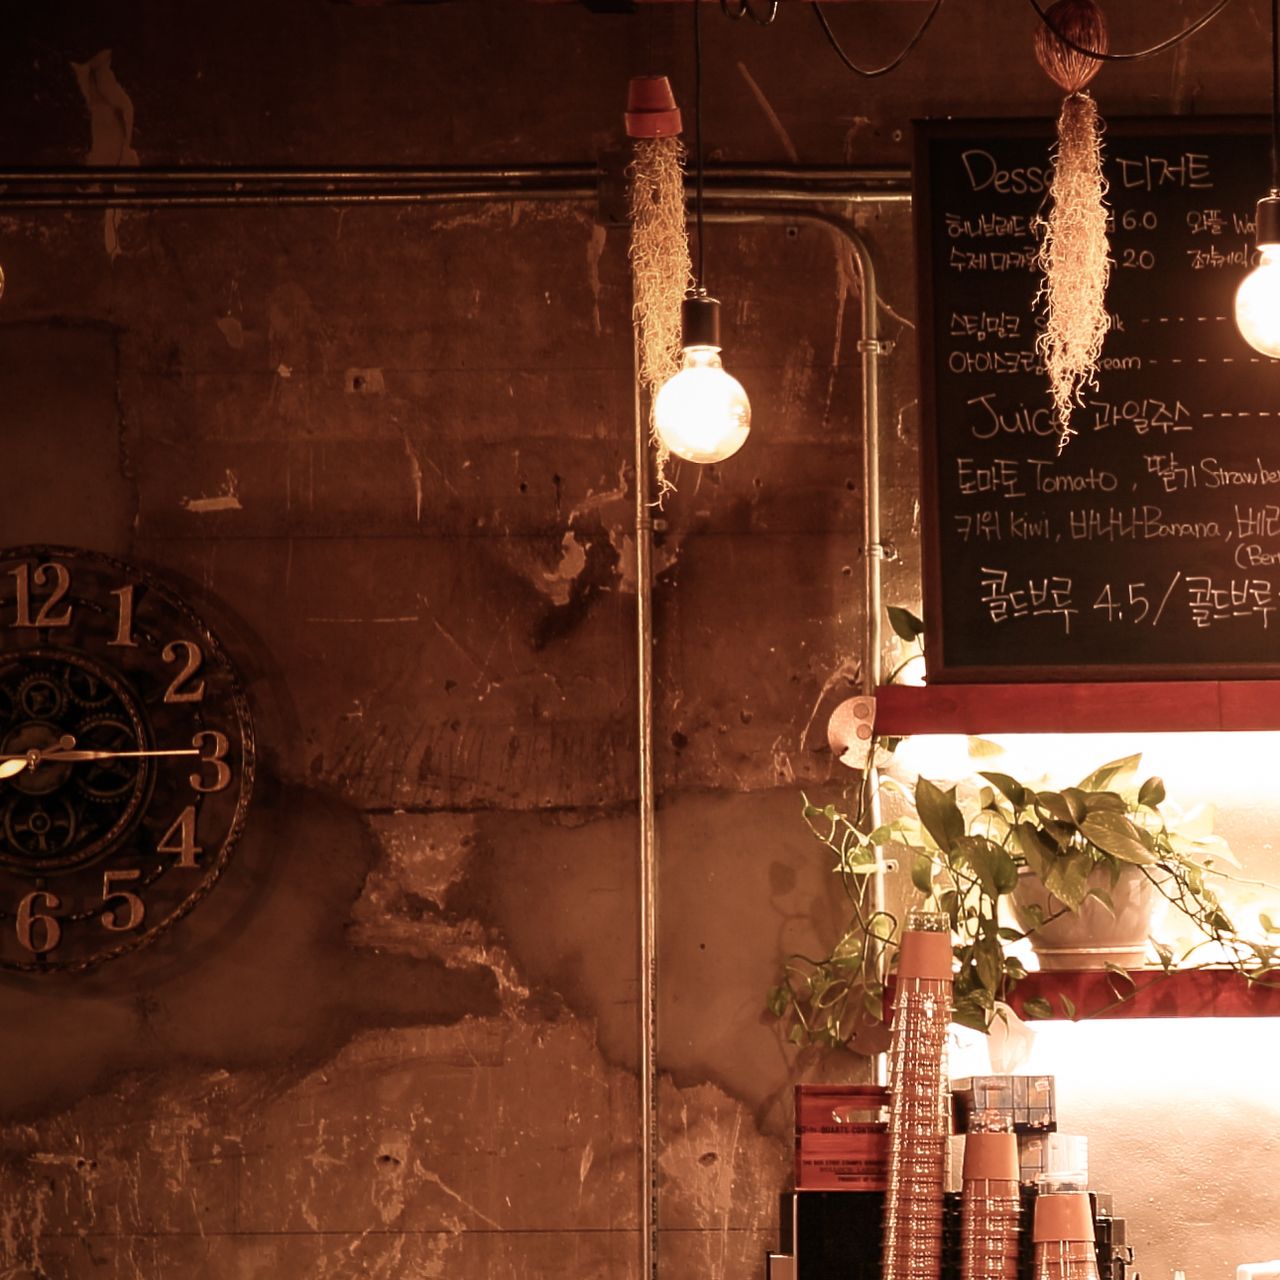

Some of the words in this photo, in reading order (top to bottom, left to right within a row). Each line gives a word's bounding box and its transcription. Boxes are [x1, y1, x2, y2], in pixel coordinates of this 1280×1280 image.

[1116, 153, 1213, 192] 디저트
[1123, 209, 1157, 231] 6.0
[950, 246, 986, 271] 수제
[1123, 247, 1155, 270] 2.0
[950, 312, 1020, 341] 스팀밀크
[957, 458, 1026, 498] 토마토
[1143, 453, 1197, 493] 딸기
[954, 510, 1001, 541] 키위
[8, 562, 73, 628] 12
[107, 584, 138, 648] 1
[161, 640, 206, 703] 2
[189, 731, 231, 793] 3
[157, 805, 203, 869] 4
[15, 890, 61, 954] 6
[101, 869, 146, 932] 5
